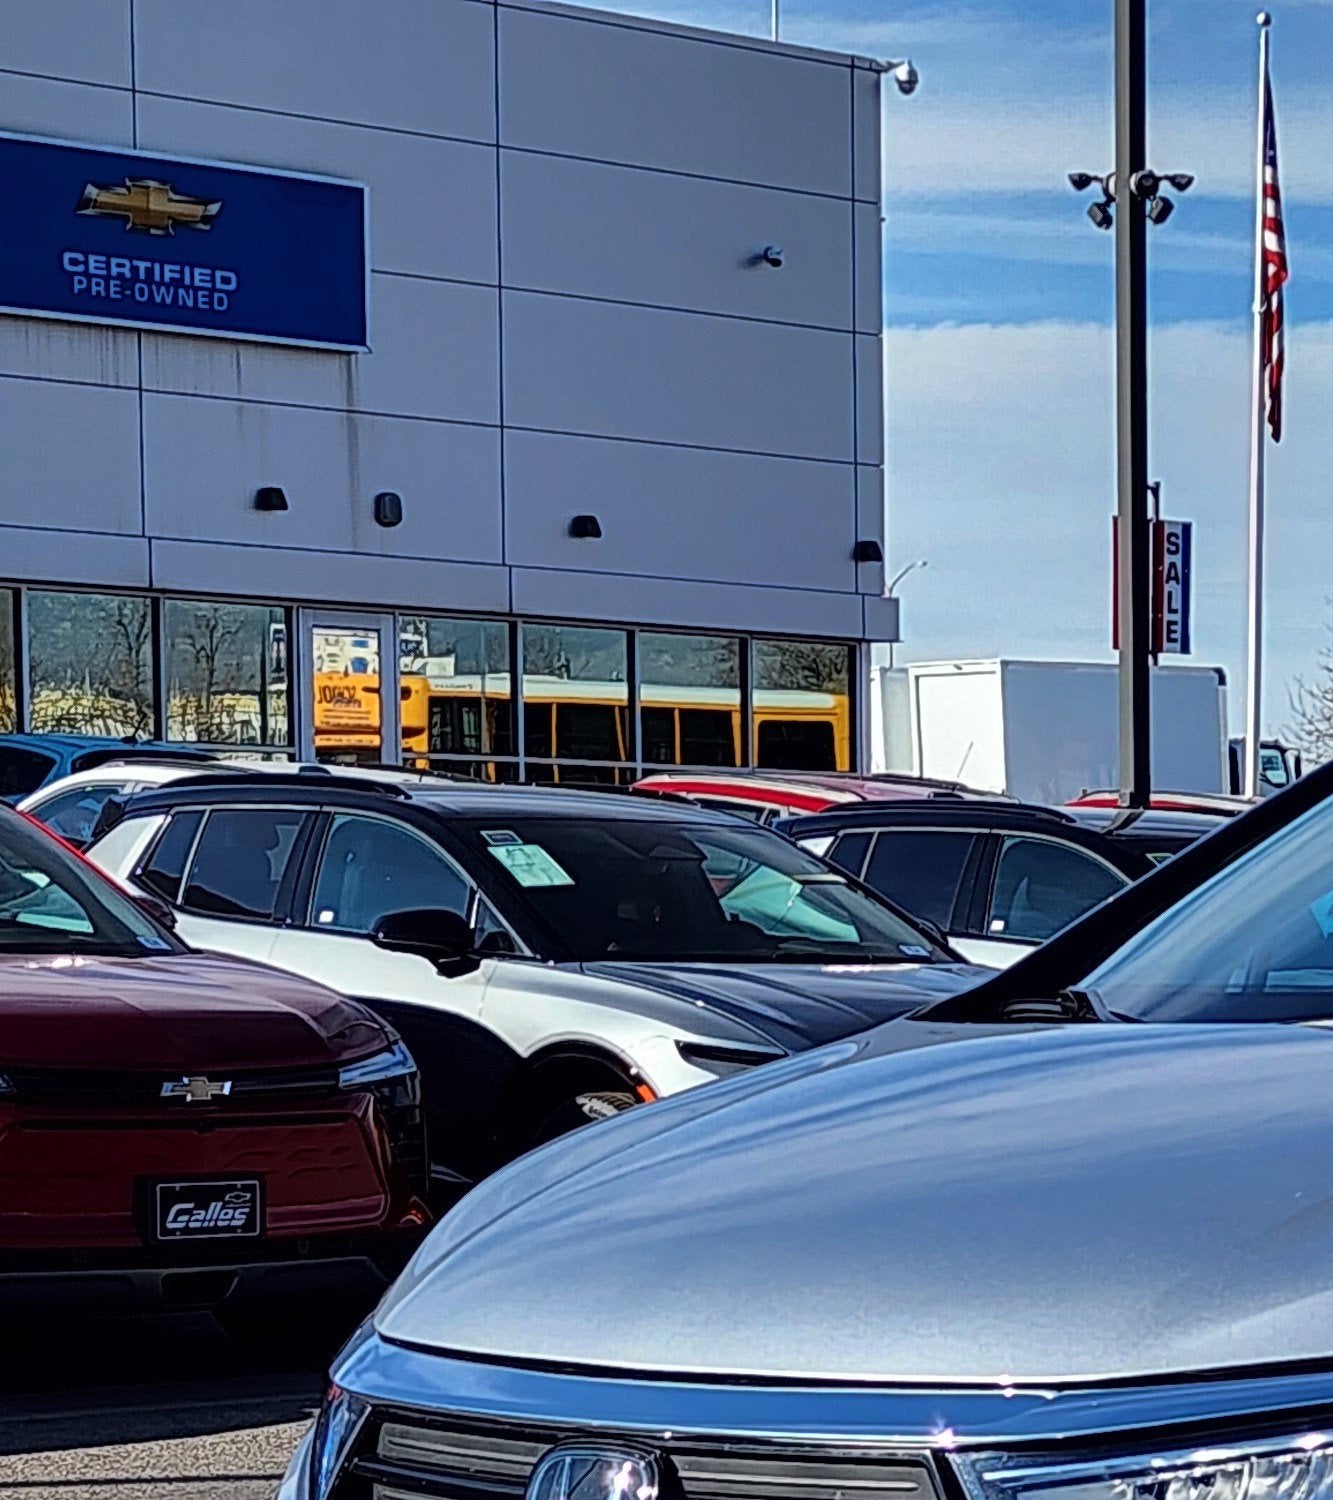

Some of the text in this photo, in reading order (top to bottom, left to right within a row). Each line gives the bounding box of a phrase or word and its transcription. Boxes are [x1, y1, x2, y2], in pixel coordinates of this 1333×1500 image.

[62, 251, 238, 292] CERTIFIED
[73, 275, 230, 311] PRE-OWNED
[1165, 532, 1181, 643] SALE
[166, 1201, 251, 1229] Galles
